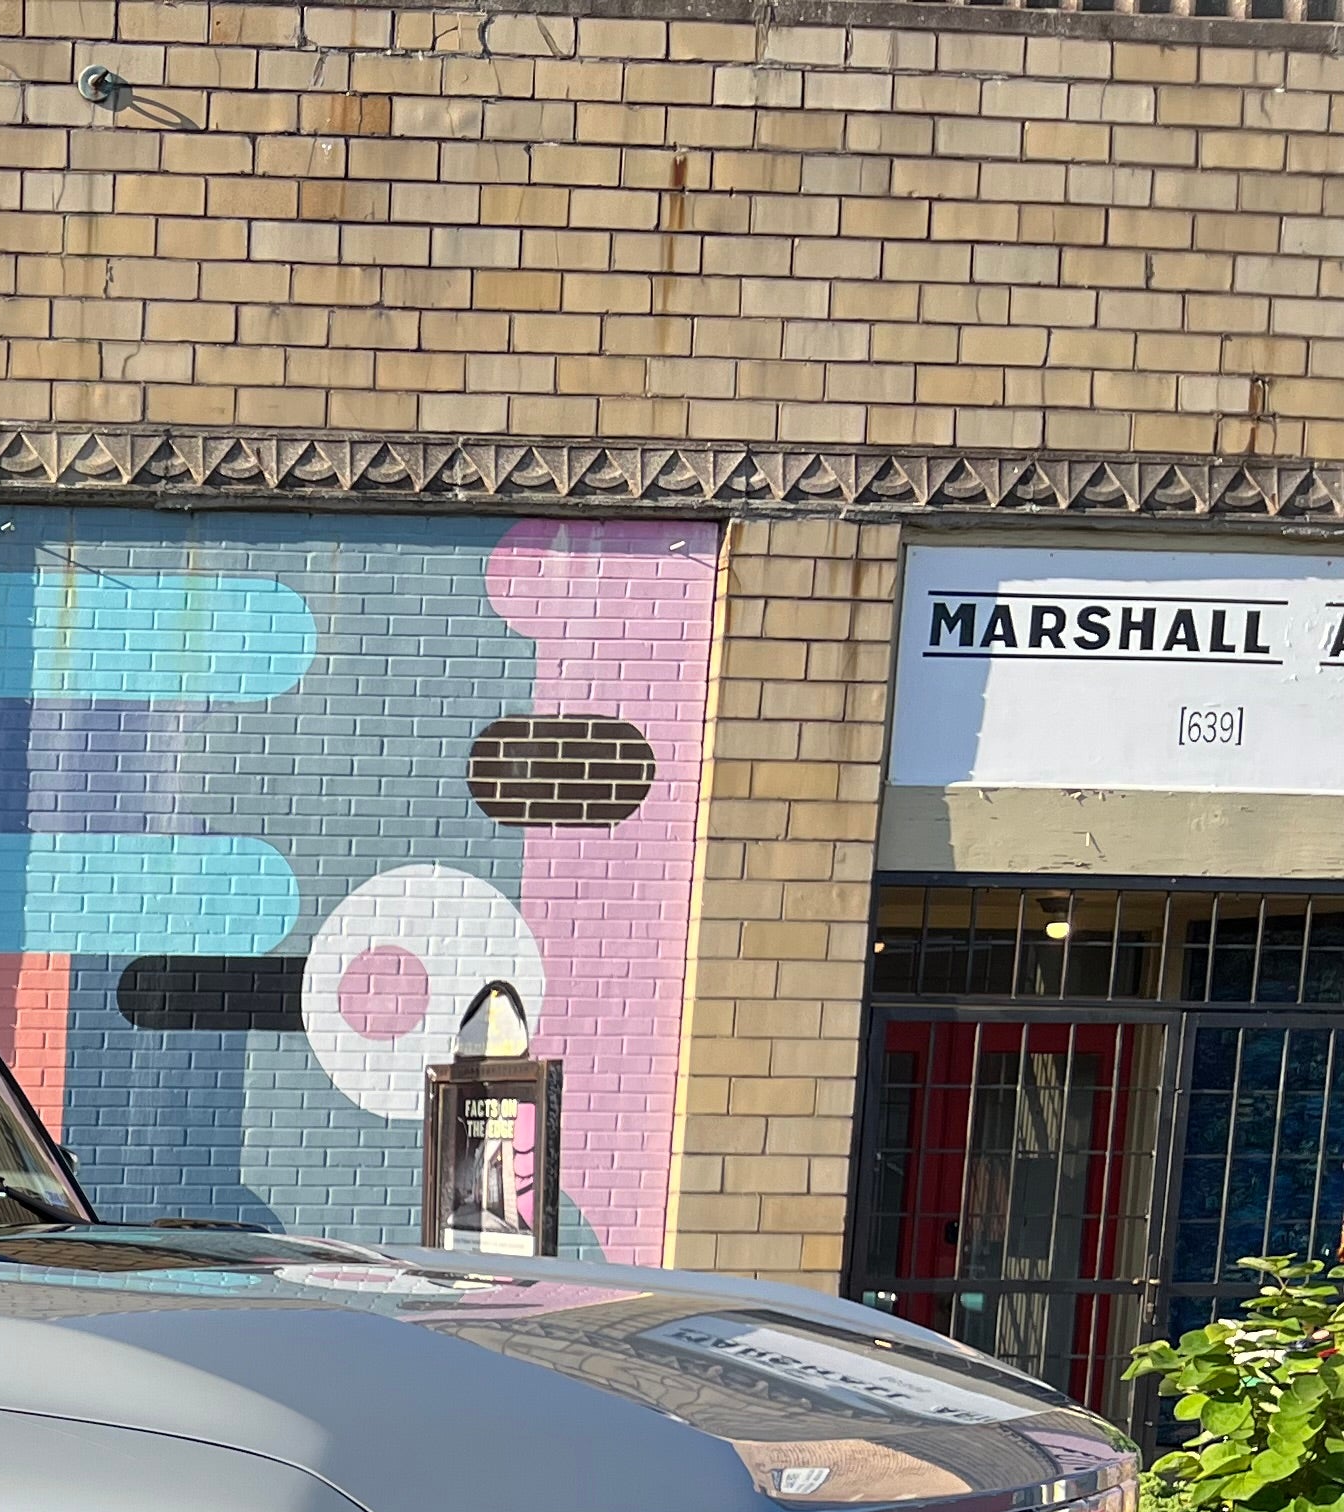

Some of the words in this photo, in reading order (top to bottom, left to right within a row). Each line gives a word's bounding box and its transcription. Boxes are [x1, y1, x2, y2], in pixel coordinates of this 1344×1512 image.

[929, 602, 1271, 655] MARSHALL
[1178, 706, 1244, 746] [639]
[464, 1098, 499, 1118] FACTS
[500, 1098, 518, 1119] ON
[466, 1119, 486, 1138] THE
[487, 1119, 515, 1140] EDGE
